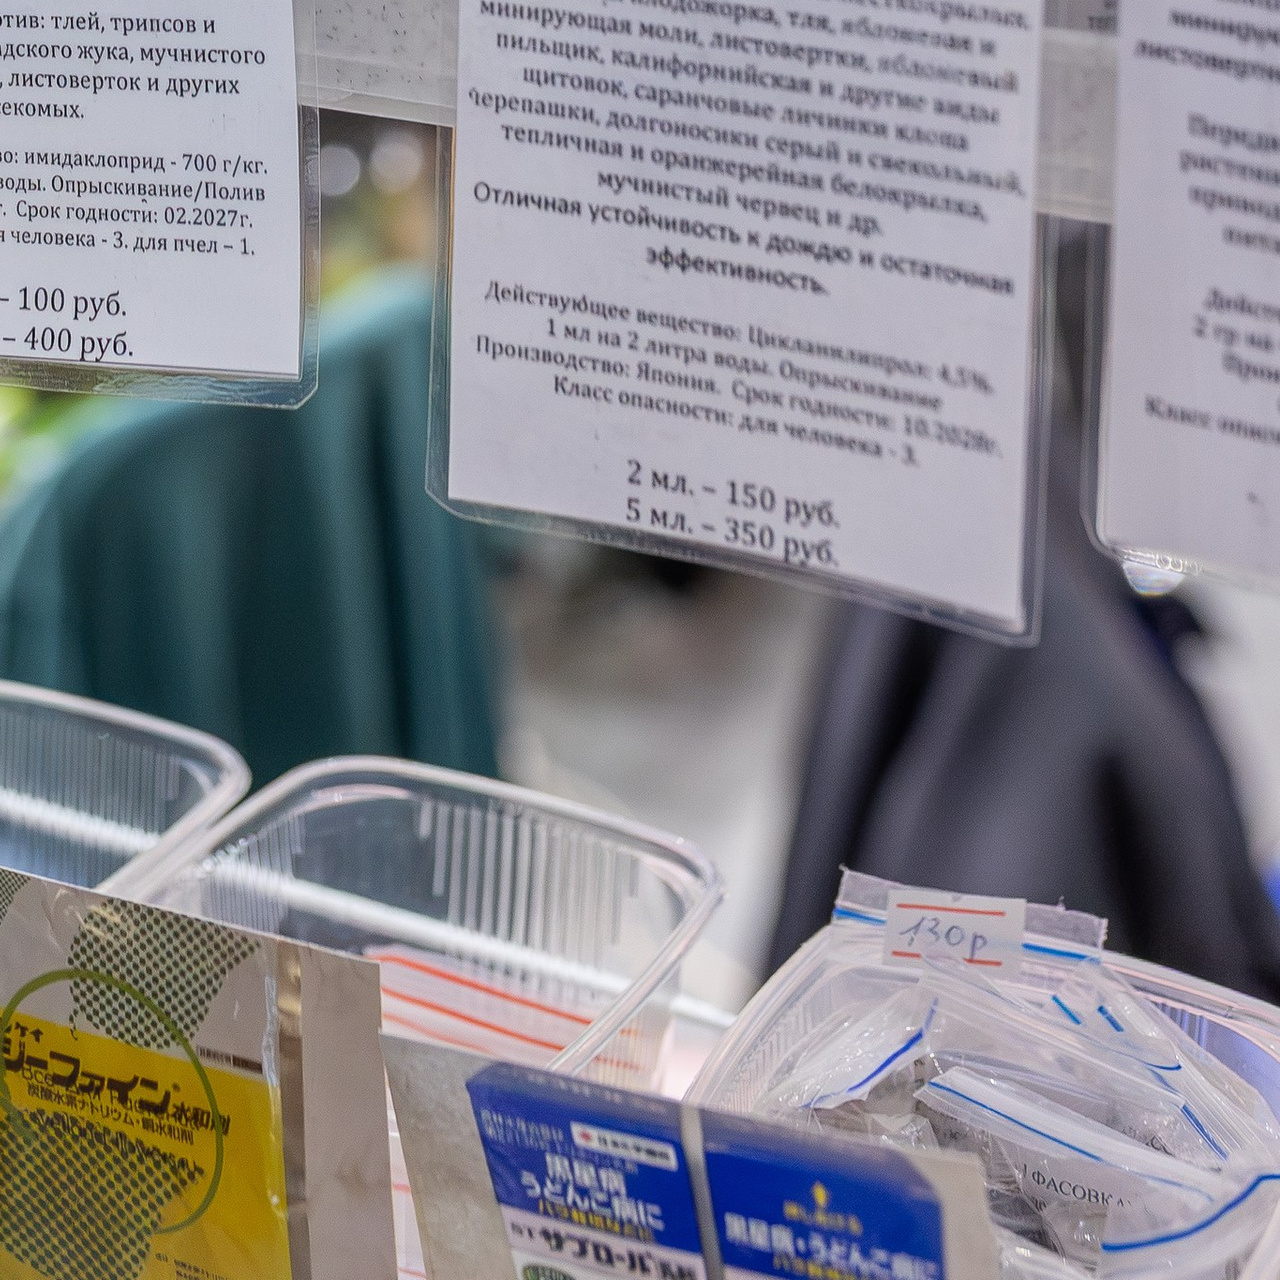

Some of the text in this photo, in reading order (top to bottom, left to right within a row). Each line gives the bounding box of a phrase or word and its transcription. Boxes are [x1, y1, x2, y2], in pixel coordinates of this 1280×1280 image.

[50, 11, 105, 34] тлей,
[110, 17, 197, 37] трипсов
[203, 19, 215, 34] и
[77, 45, 134, 65] жука,
[140, 47, 265, 67] мучнистого
[8, 73, 141, 95] листоверток
[147, 77, 159, 92] и
[165, 77, 240, 98] других
[16, 199, 61, 222] Срок
[66, 206, 157, 224] годности:
[164, 206, 253, 228] 02.2027г.
[19, 286, 65, 313] 100
[73, 290, 126, 322] руб.
[24, 326, 72, 352] 400
[80, 330, 133, 365] руб.
